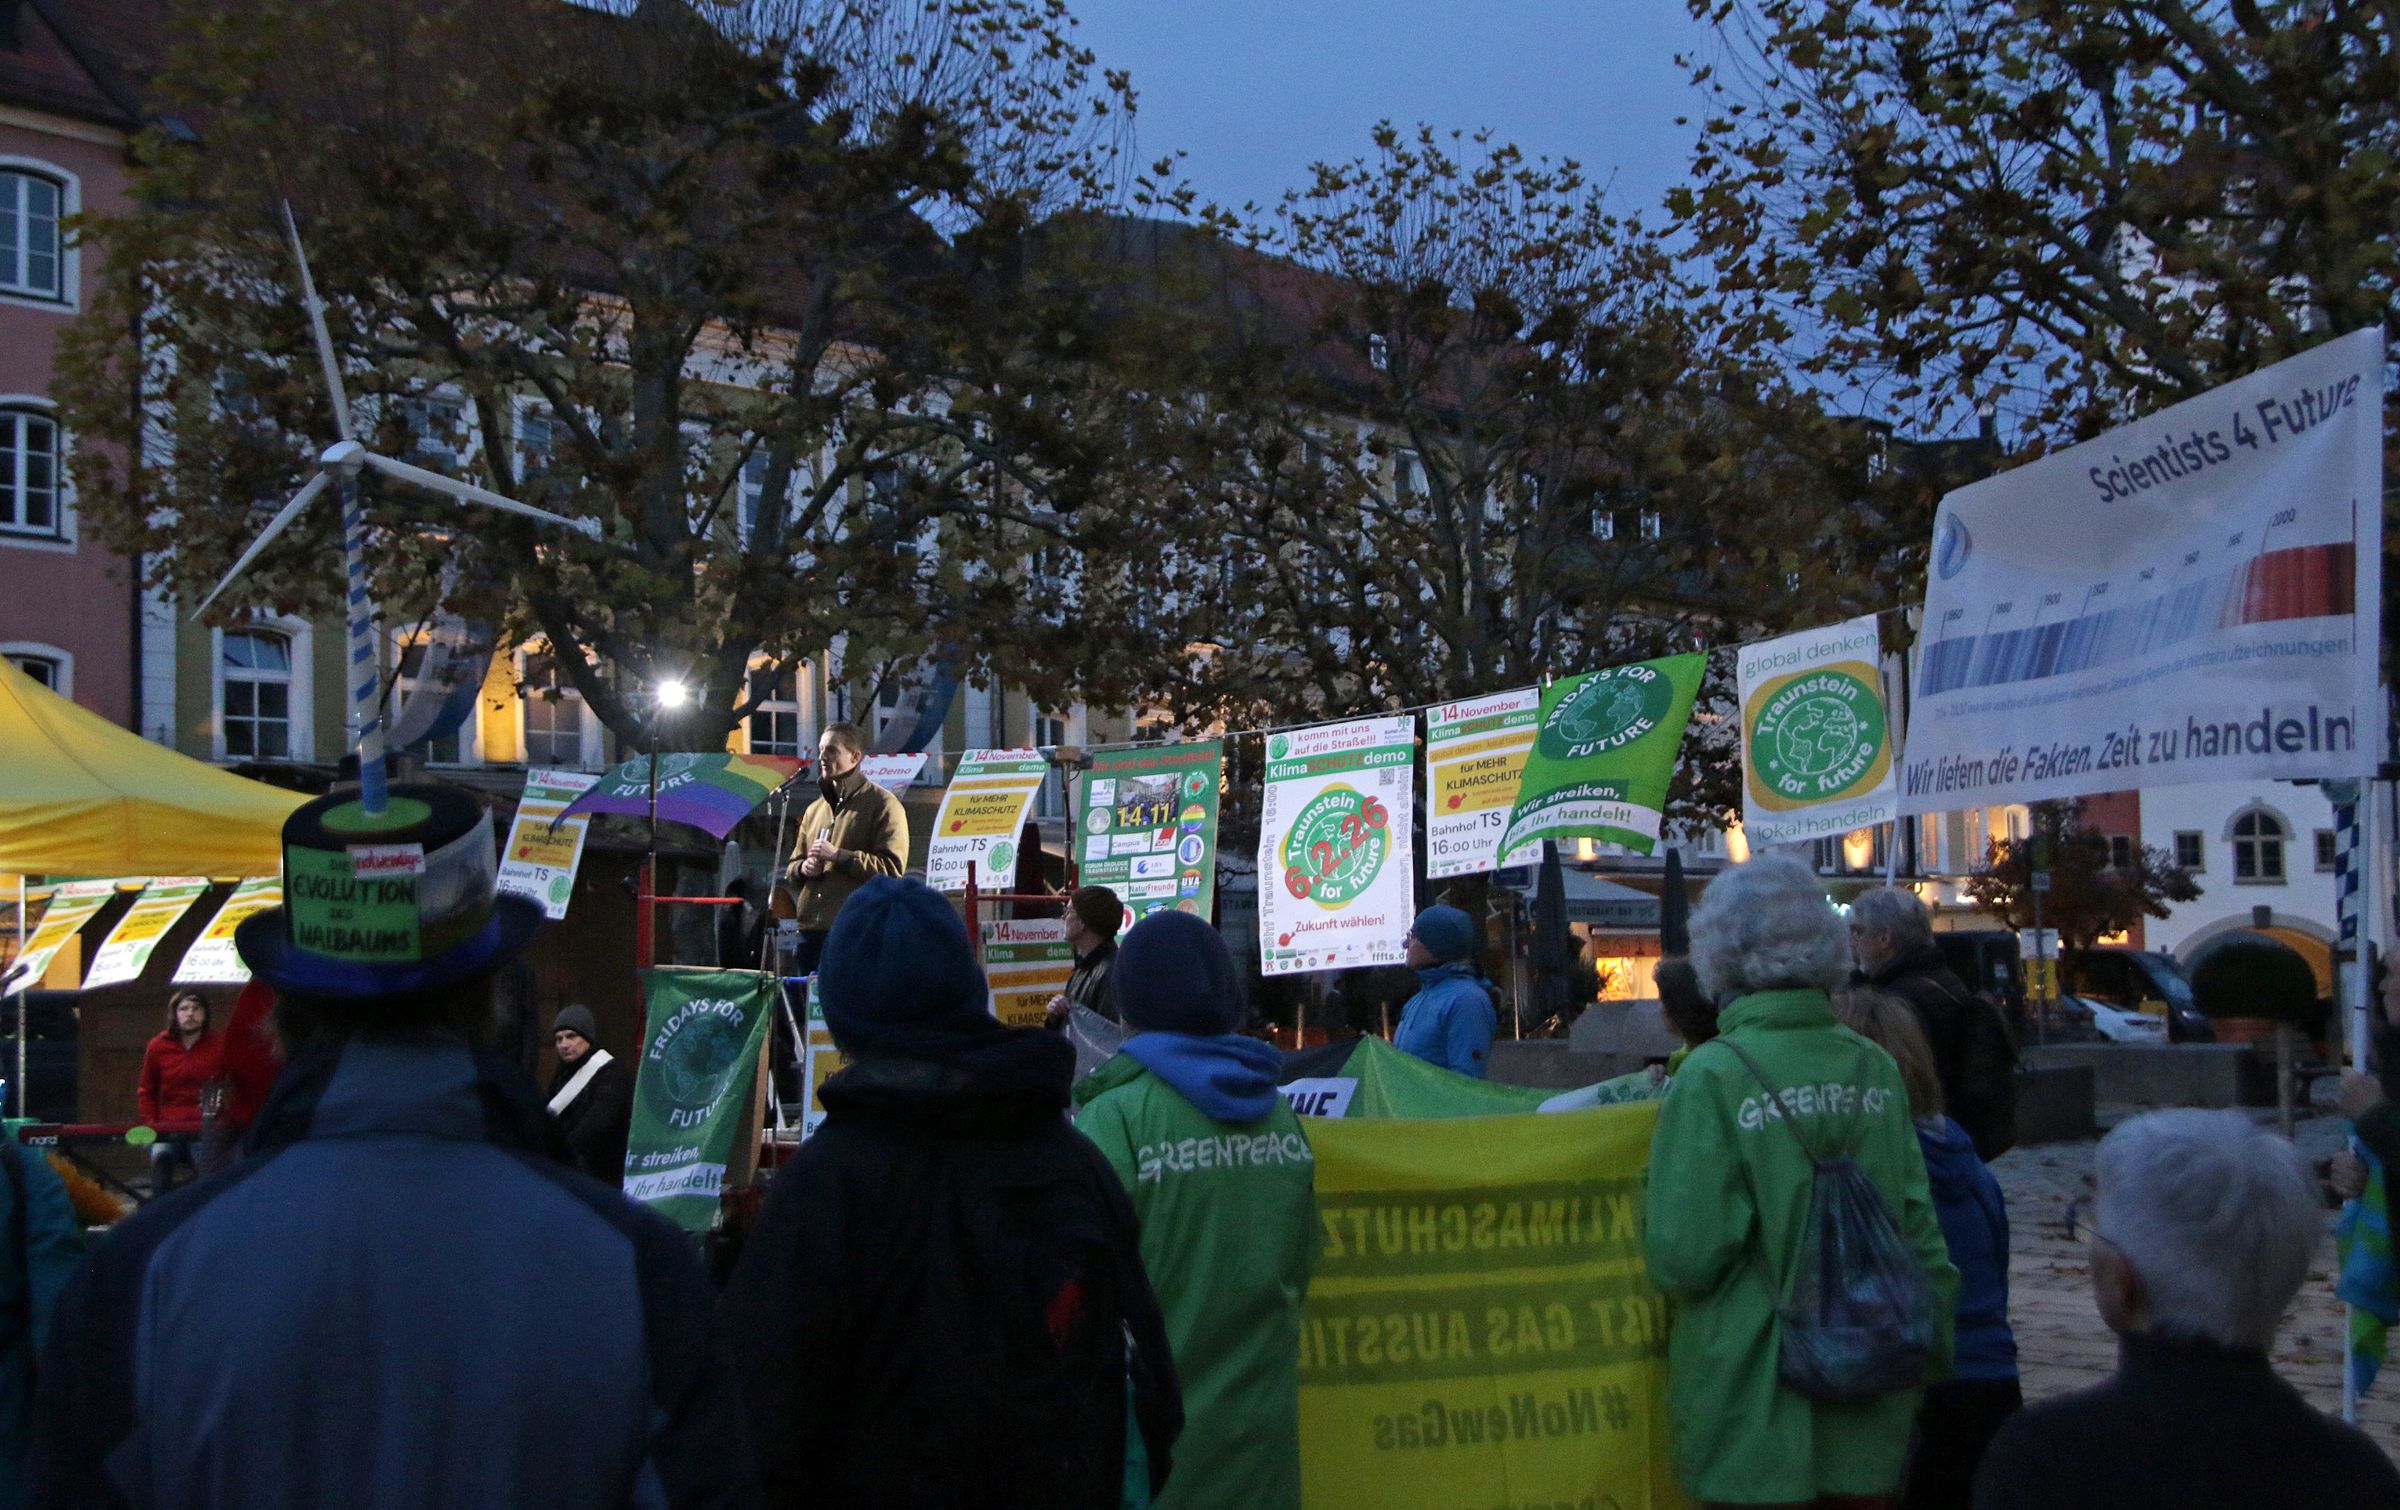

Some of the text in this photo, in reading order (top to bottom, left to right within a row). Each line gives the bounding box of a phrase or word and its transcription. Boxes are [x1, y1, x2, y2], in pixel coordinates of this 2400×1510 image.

[2089, 373, 2361, 503] Scientists 4 Future
[1745, 633, 1877, 680] global denken
[1544, 666, 1657, 730] FRIDAYS FOR
[1756, 675, 1858, 737] Traunstein
[1441, 704, 1459, 722] 14
[1461, 700, 1521, 720] November
[1294, 745, 1310, 756] auf
[1312, 741, 1329, 753] die
[1331, 735, 1376, 750] Straße!!!
[1297, 725, 1370, 743] komm mit uns
[1567, 717, 1653, 758] FUTURE
[975, 750, 1038, 763] 14 November
[1270, 750, 1407, 779] KlimaSCHUTZdemo
[1460, 757, 1507, 774] für MEHR
[1777, 742, 1873, 794] for future
[1907, 757, 1934, 796] Wir
[1935, 754, 1983, 793] liefern
[1987, 746, 2019, 785] die
[2021, 742, 2092, 782] Fakten.
[2097, 723, 2142, 770] Zeit
[2148, 728, 2178, 764] zu
[1446, 769, 1524, 791] KLIMASCHUTZ
[954, 805, 1018, 816] KLIMASCHUTZ
[970, 794, 1009, 804] für MEHR
[1518, 799, 1541, 818] Wir
[1546, 783, 1621, 804] streiken,
[1117, 803, 1177, 828] 14.11.
[1288, 793, 1355, 861] Traunstein
[1432, 811, 1502, 837] Bahnhof TS
[1531, 811, 1552, 827] Ihr
[1557, 805, 1632, 824] handelt!
[1756, 805, 1886, 842] lokal handeln
[932, 838, 988, 855] Bahnhof TS
[1284, 795, 1389, 900] 6.2.26
[1432, 838, 1493, 856] 16:00 Uhr
[534, 867, 550, 881] TS
[930, 857, 958, 872] 16:00
[1320, 837, 1380, 899] for future
[293, 873, 418, 905] EVOLUTION
[995, 922, 1059, 941] 14 November
[1295, 914, 1386, 933] Zukunft wählen!
[300, 921, 411, 952] MAIBAUMS
[650, 998, 745, 1061] FRIDAYS FOR
[28, 1134, 59, 1145] nord
[633, 1180, 654, 1198] Ihr
